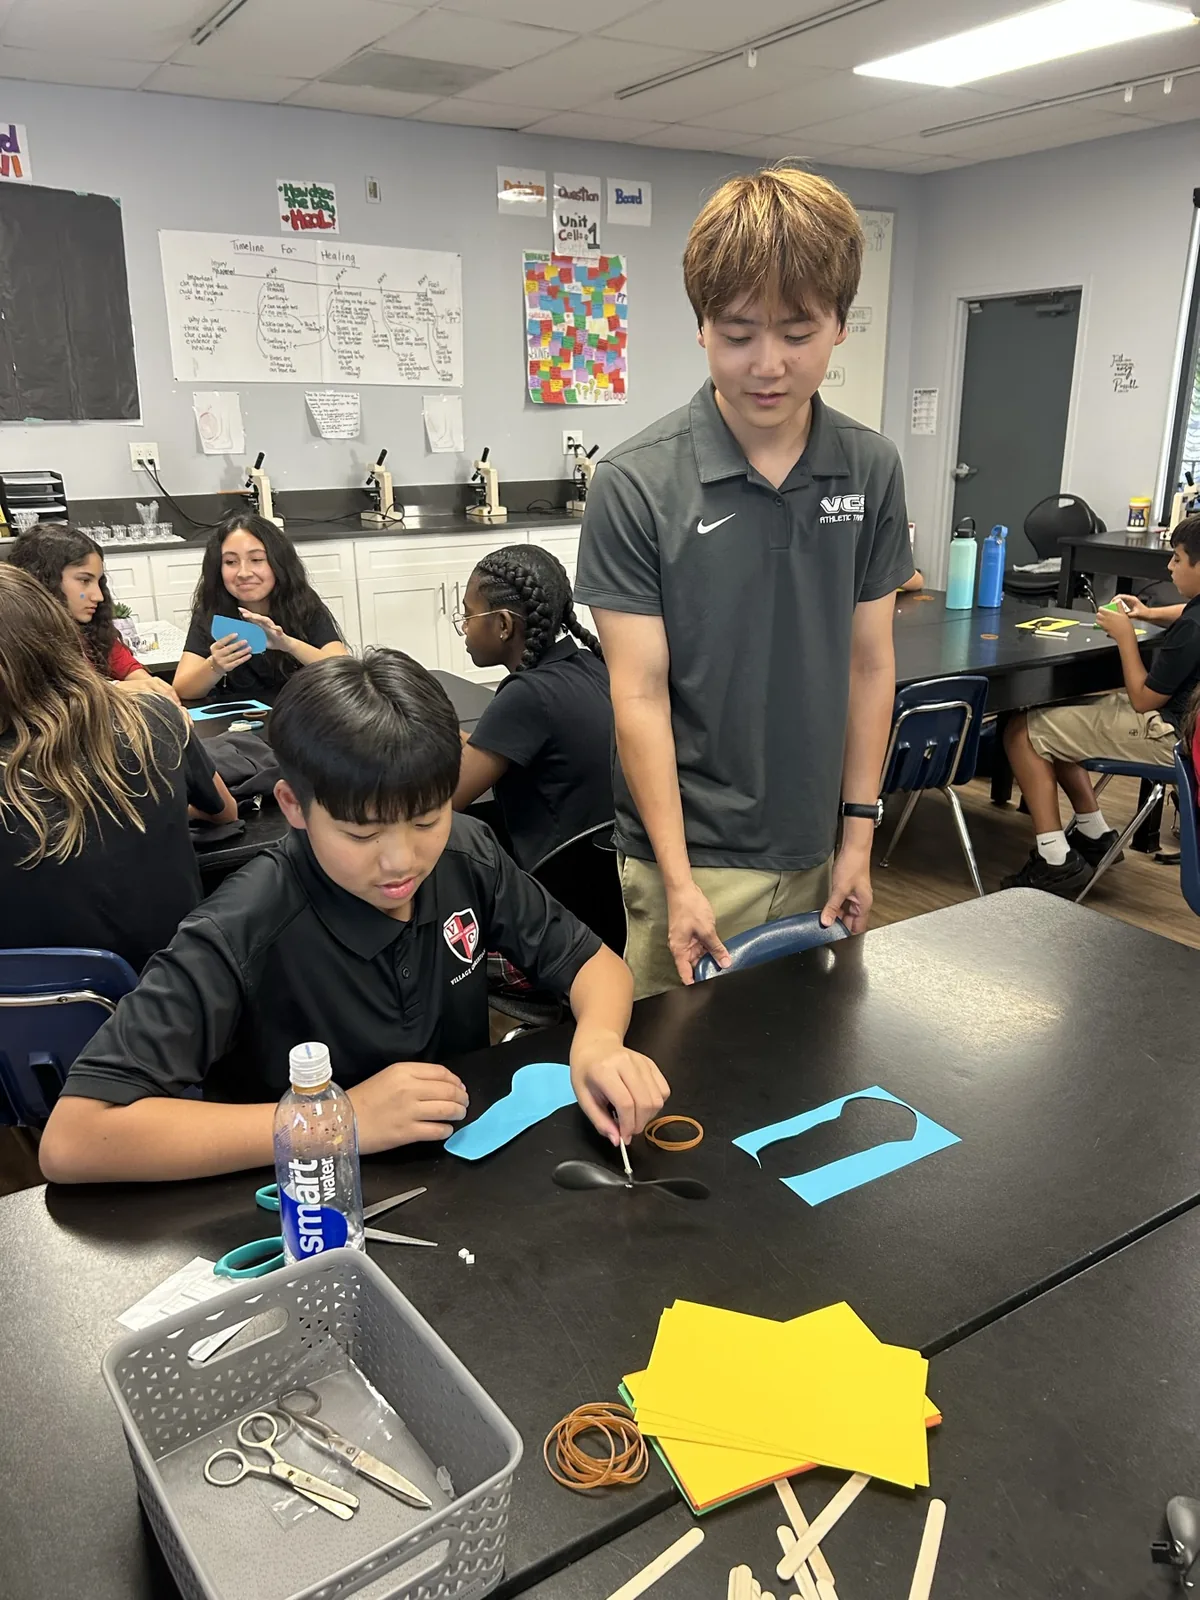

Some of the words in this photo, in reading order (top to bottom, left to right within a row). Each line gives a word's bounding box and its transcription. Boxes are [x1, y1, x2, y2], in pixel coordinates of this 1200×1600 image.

[283, 183, 308, 198] How
[309, 183, 335, 201] does
[558, 186, 599, 202] Question
[615, 188, 643, 205] Board
[284, 196, 309, 209] the
[310, 197, 336, 218] body
[558, 229, 583, 241] Cells
[559, 215, 588, 228] Unit
[587, 222, 600, 249] 1
[230, 239, 265, 253] Timeline
[281, 243, 297, 254] For
[320, 250, 356, 268] Healing
[819, 513, 851, 524] ATHLETIC
[446, 923, 456, 935] V
[467, 932, 476, 944] C
[450, 968, 472, 985] VILLAGE
[288, 1158, 325, 1253] smart
